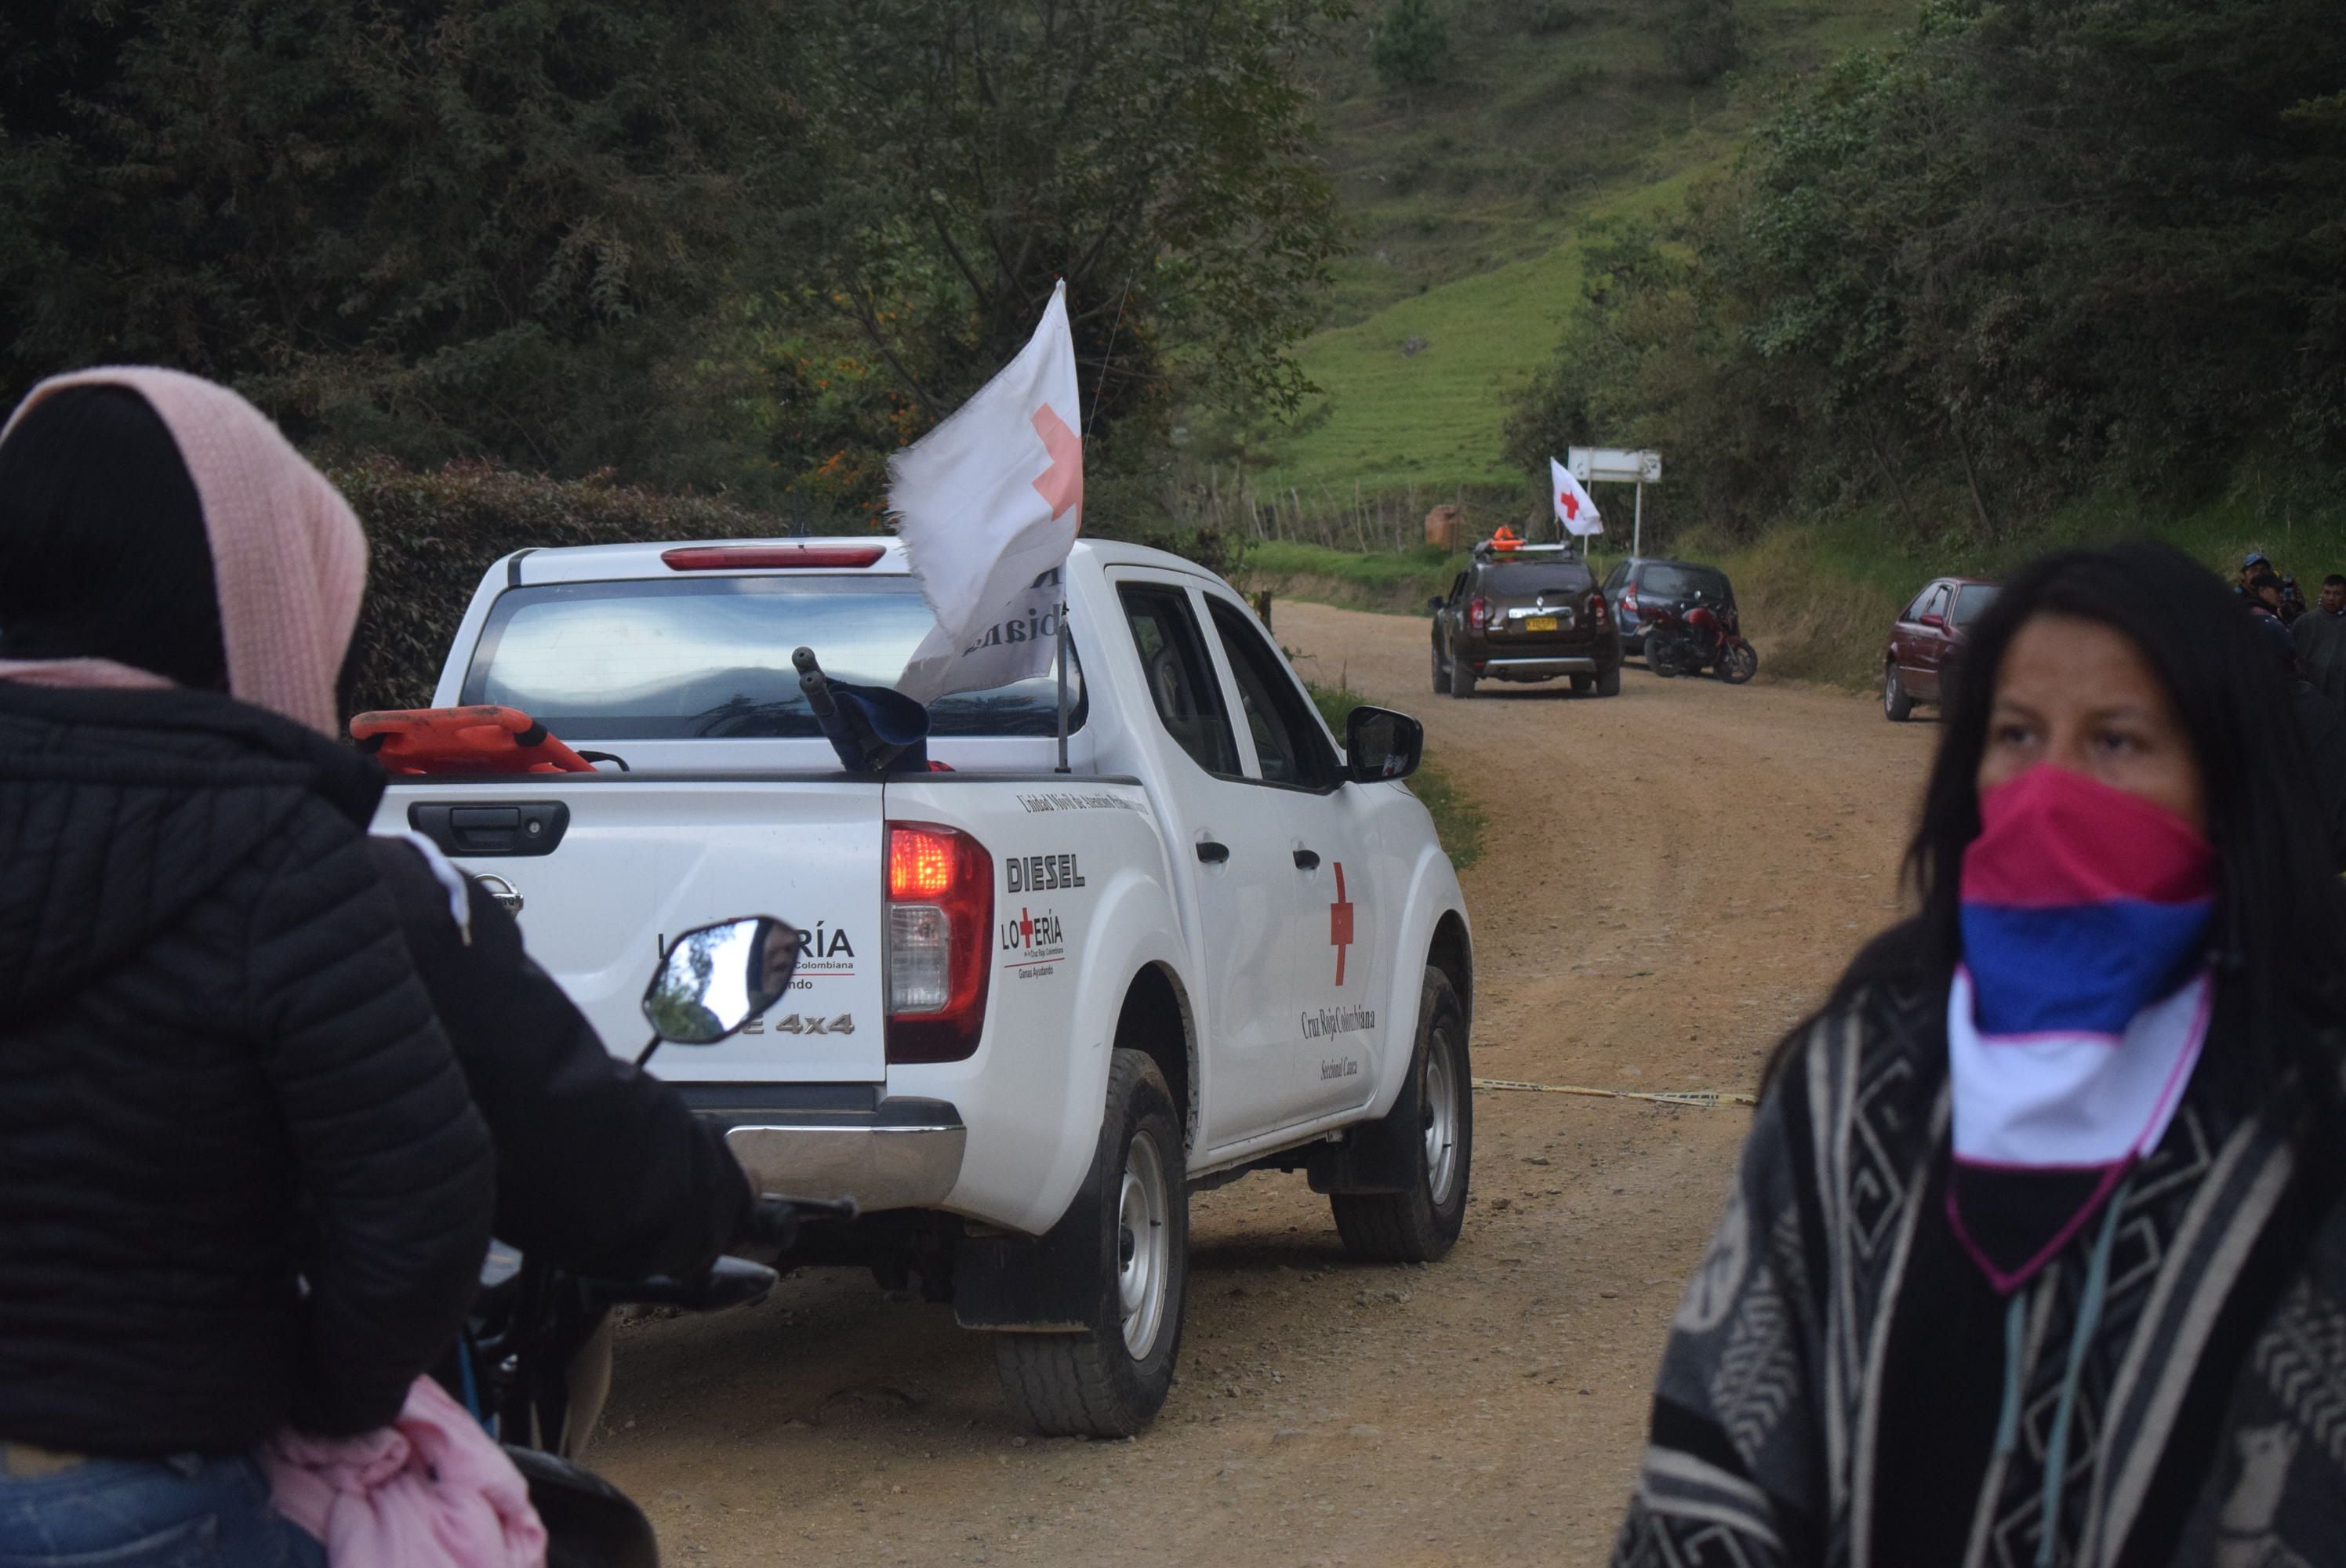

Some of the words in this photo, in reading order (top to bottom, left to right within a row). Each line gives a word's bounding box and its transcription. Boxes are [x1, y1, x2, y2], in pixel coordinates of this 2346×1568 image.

[1006, 854, 1085, 894] DIESEL
[795, 961, 854, 970] Colombiana
[775, 1011, 855, 1035] 4x4
[1301, 1011, 1320, 1040] Cruz
[1319, 1007, 1337, 1042] Roja
[1335, 1004, 1375, 1033] Colombiana
[1320, 1056, 1343, 1080] Seccional
[1343, 1055, 1358, 1077] Cauca
